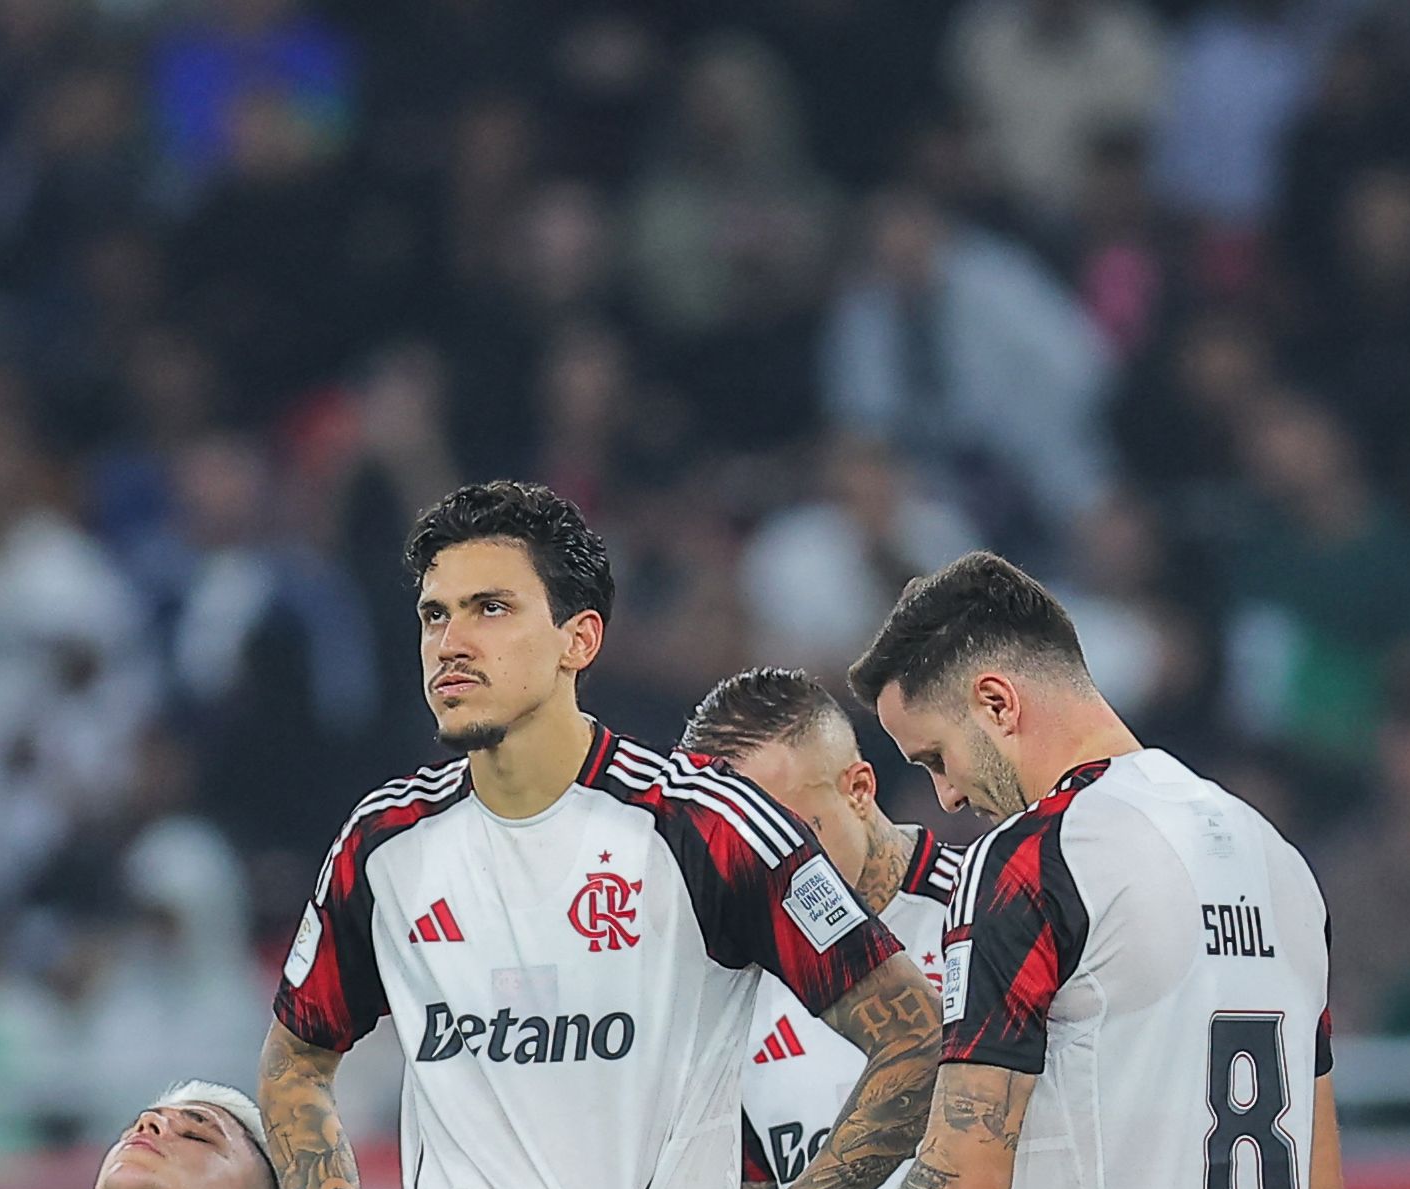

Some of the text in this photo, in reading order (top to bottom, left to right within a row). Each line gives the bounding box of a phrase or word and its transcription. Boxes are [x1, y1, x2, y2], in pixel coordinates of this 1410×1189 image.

[800, 880, 836, 910] UNITES
[1201, 895, 1275, 958] SAÚL
[415, 1002, 635, 1064] Betano
